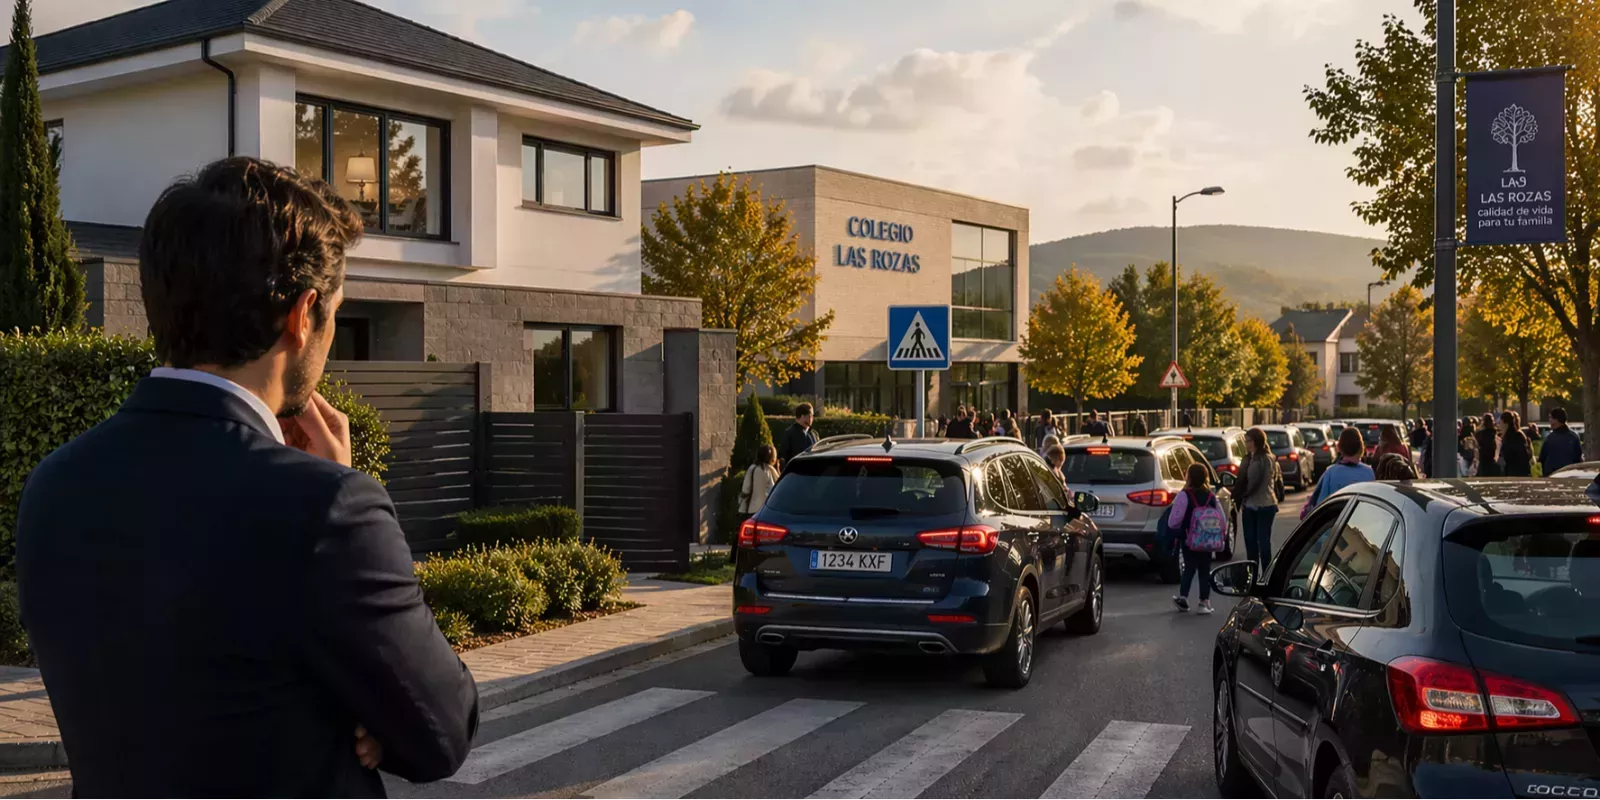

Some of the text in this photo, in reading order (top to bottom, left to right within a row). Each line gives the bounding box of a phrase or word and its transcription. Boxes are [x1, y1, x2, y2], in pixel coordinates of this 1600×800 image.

[1481, 190, 1552, 204] LAS ROZAS
[1477, 205, 1553, 217] calidad de vida
[846, 215, 914, 243] COLEGIO
[1478, 218, 1501, 229] para
[1504, 218, 1515, 226] tu
[833, 243, 921, 274] LAS ROZAS
[821, 553, 854, 568] 1234
[858, 554, 887, 570] KXF
